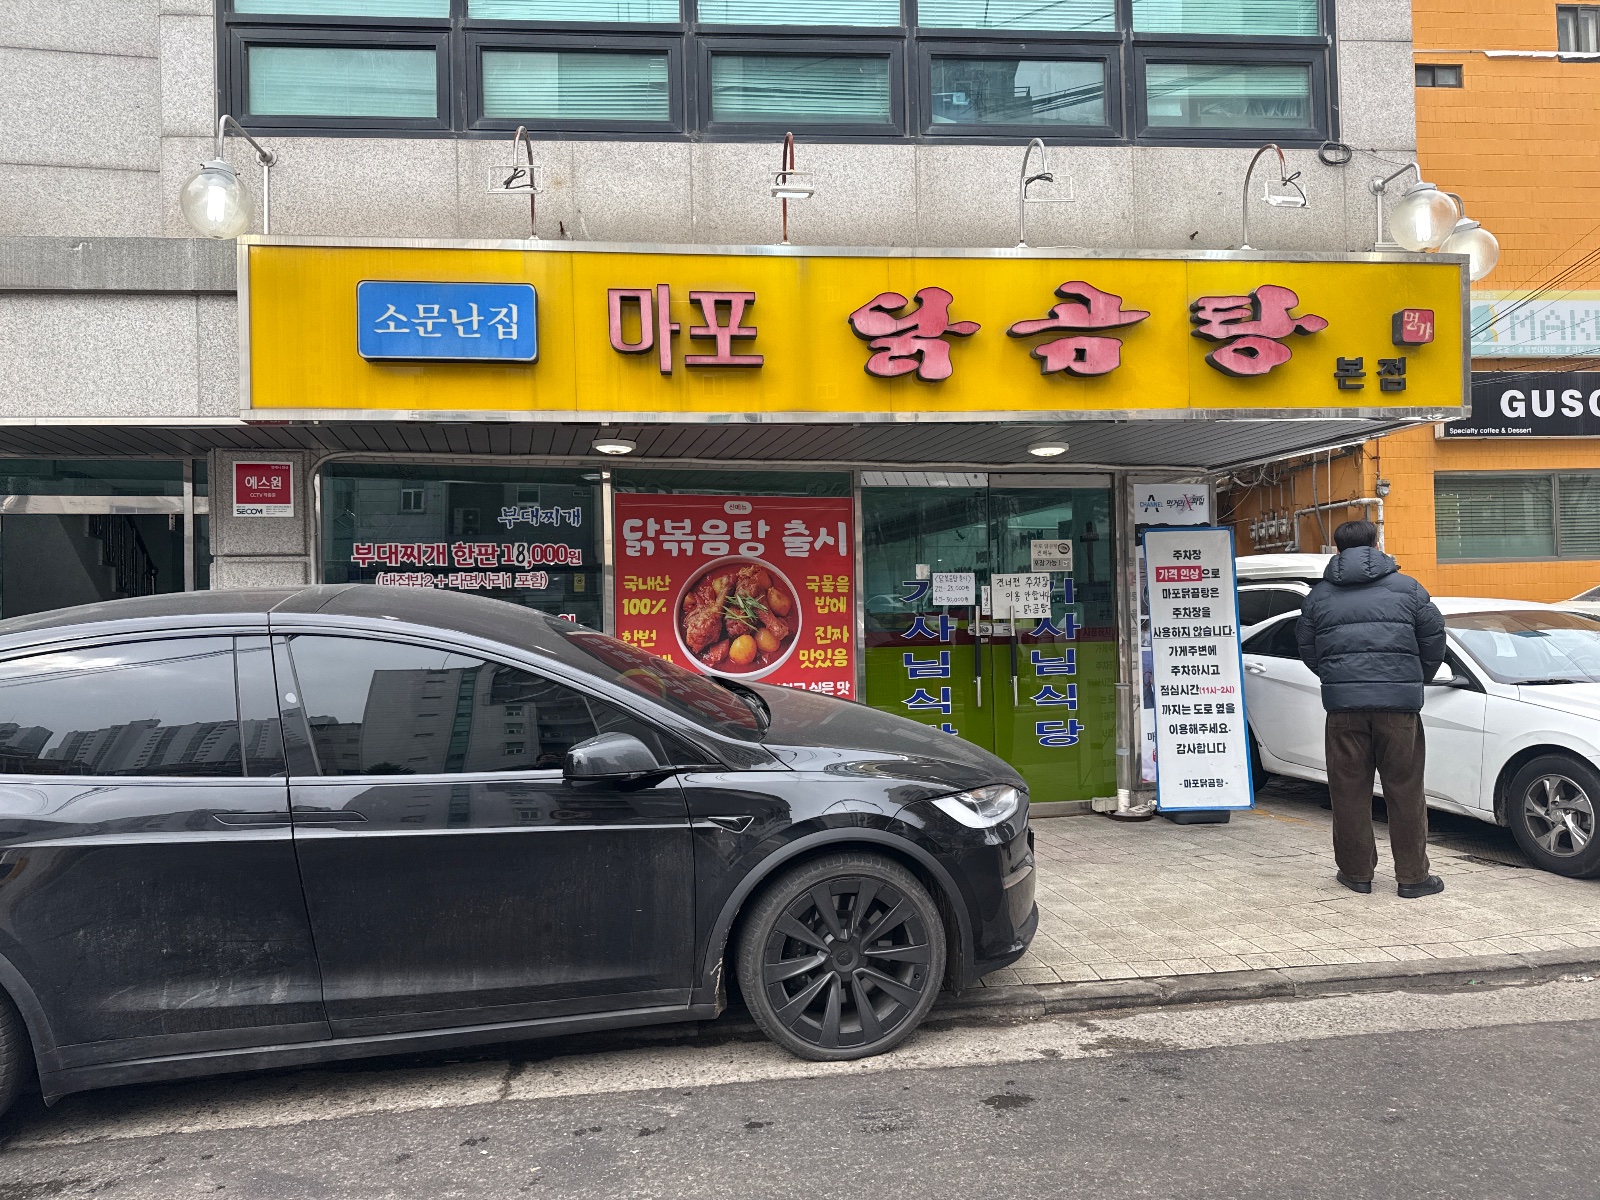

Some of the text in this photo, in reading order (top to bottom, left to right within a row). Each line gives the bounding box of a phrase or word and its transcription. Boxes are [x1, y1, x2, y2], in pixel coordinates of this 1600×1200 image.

[373, 302, 519, 341] 소문난집
[607, 284, 765, 375] 마포
[1404, 311, 1433, 341] 명가
[1334, 356, 1406, 391] 본점
[1449, 427, 1478, 435] Specialty
[244, 475, 282, 490] 에스원
[498, 507, 582, 529] 부대찌개
[622, 517, 848, 558] 닭볶음탕 출시
[351, 541, 582, 569] 부대찌개 한판 18,000원
[1172, 549, 1202, 560] 주차장
[514, 571, 549, 589] 포함)
[1158, 567, 1221, 580] 가격 인상으로
[622, 575, 671, 592] 국내산
[805, 575, 850, 593] 국물을
[1162, 587, 1220, 599] 마포닭곰탕은
[622, 598, 667, 616] 100%
[814, 596, 847, 615] 밥에
[1172, 606, 1212, 618] 주차장을
[814, 625, 850, 644] 진짜
[1153, 624, 1236, 638] 사용하지 않습니다.
[799, 648, 849, 669] 맛있음
[1168, 644, 1218, 657] 가게주변에
[1170, 664, 1221, 677] 주차하시고
[836, 680, 851, 696] 맛
[1161, 702, 1236, 716] 까지는 도로 옆을
[1168, 722, 1232, 735] 이용해주세요.
[1176, 742, 1227, 755] 감사합니다
